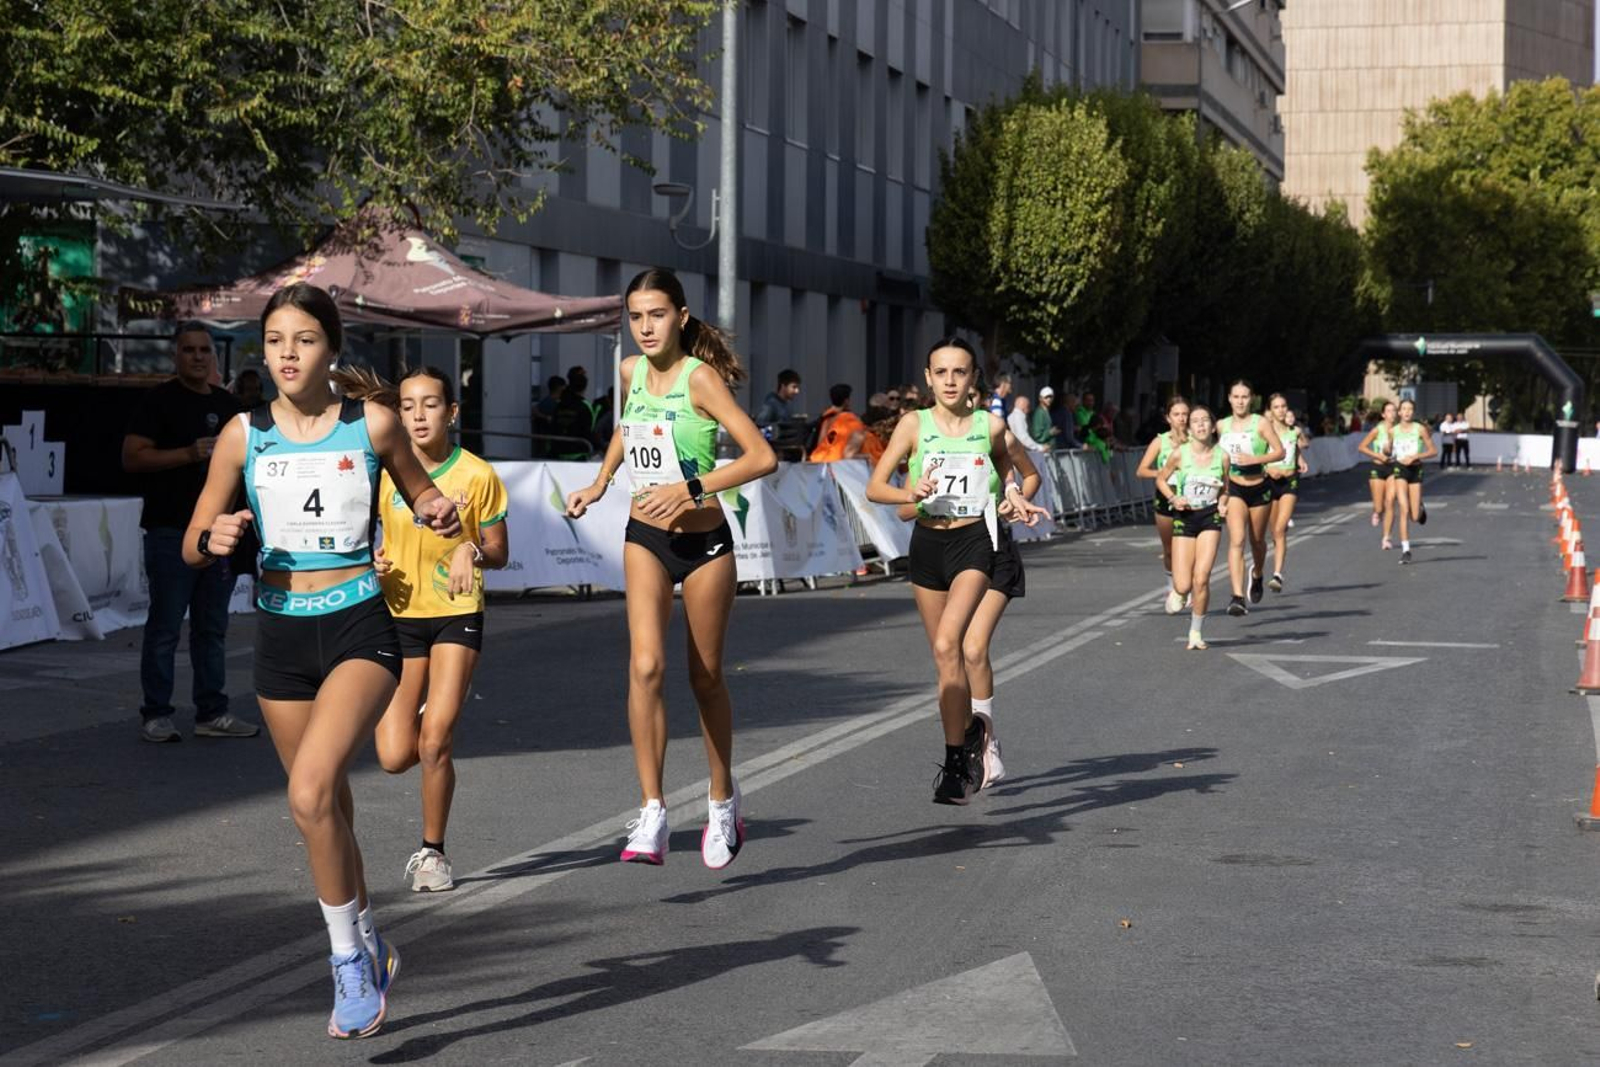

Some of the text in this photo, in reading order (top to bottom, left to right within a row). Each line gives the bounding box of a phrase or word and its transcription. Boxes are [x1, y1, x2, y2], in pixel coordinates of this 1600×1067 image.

[29, 423, 35, 450] 1
[48, 450, 55, 478] 3
[630, 446, 661, 469] 109
[931, 457, 945, 468] 37
[267, 461, 289, 477] 37
[944, 475, 968, 494] 71
[303, 488, 325, 518] 4
[289, 590, 346, 611] PRO
